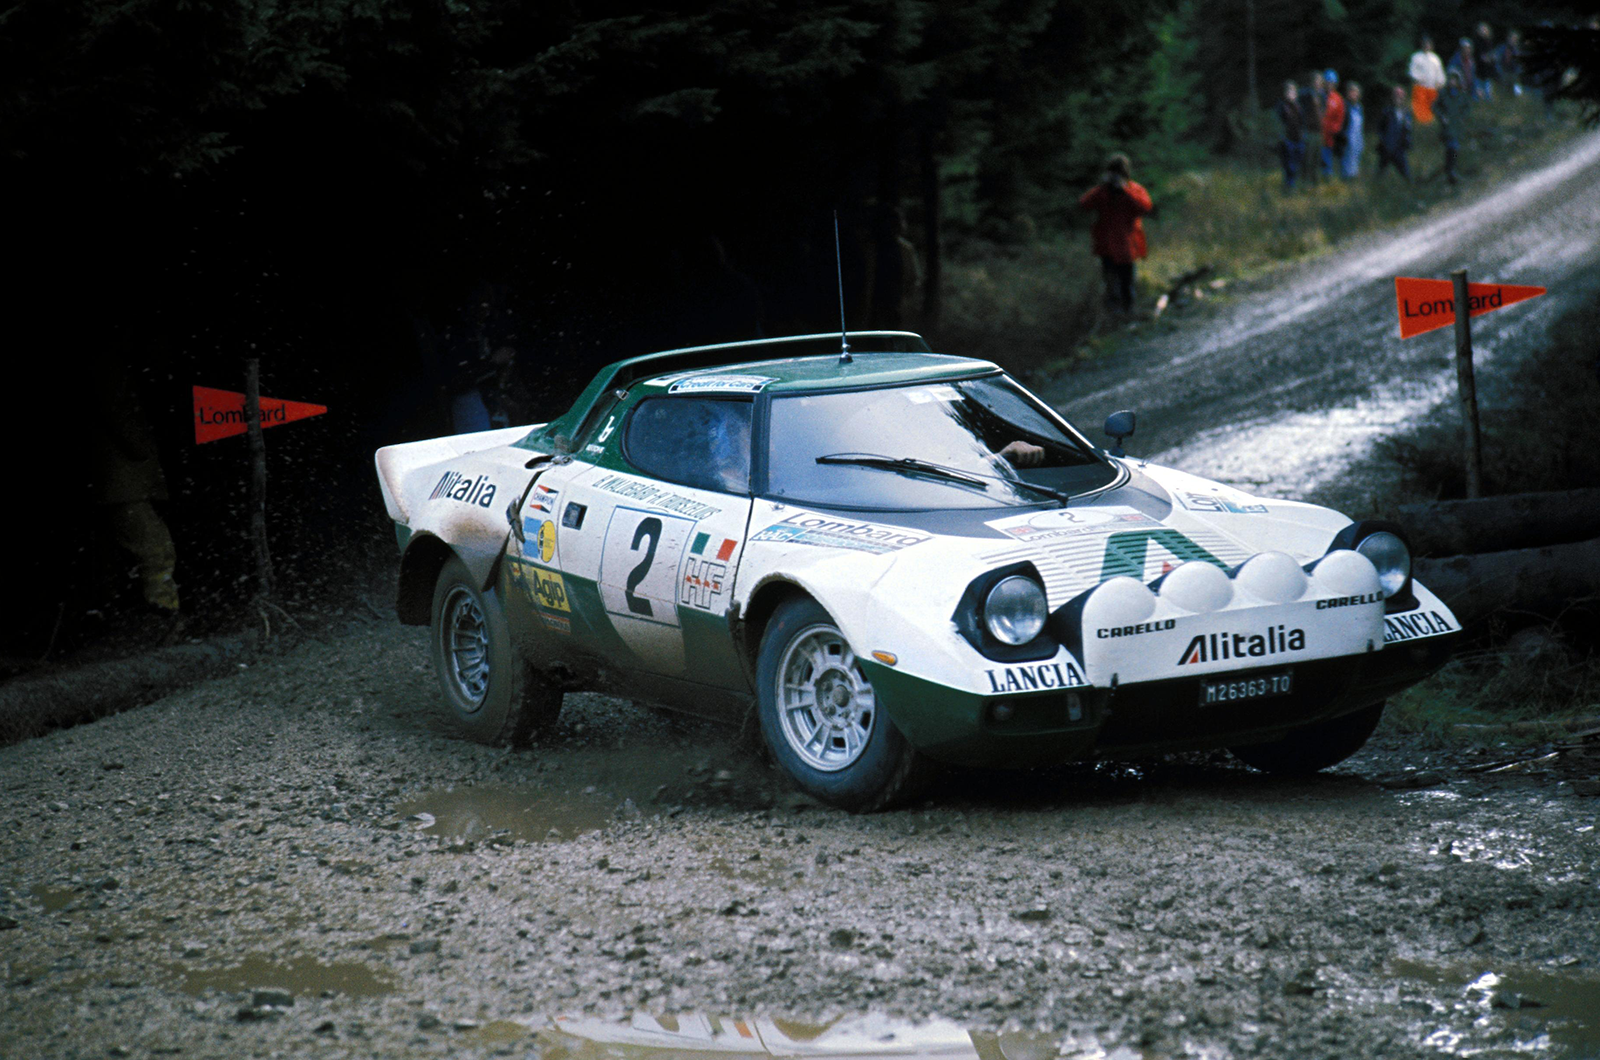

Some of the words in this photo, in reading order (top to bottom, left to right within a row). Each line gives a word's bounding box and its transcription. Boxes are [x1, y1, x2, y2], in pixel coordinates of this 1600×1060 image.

[1404, 289, 1502, 318] Lomard
[428, 471, 497, 508] Alitalia
[781, 512, 934, 546] Lombard
[1059, 511, 1084, 523] 2
[625, 517, 662, 617] 2
[681, 556, 727, 610] HF
[533, 570, 565, 607] Agip
[1316, 591, 1385, 610] CARELLO
[1096, 619, 1176, 639] CARELLO
[1176, 625, 1306, 666] Alitalia
[984, 662, 1085, 693] LANCIA
[1206, 679, 1266, 702] M26363
